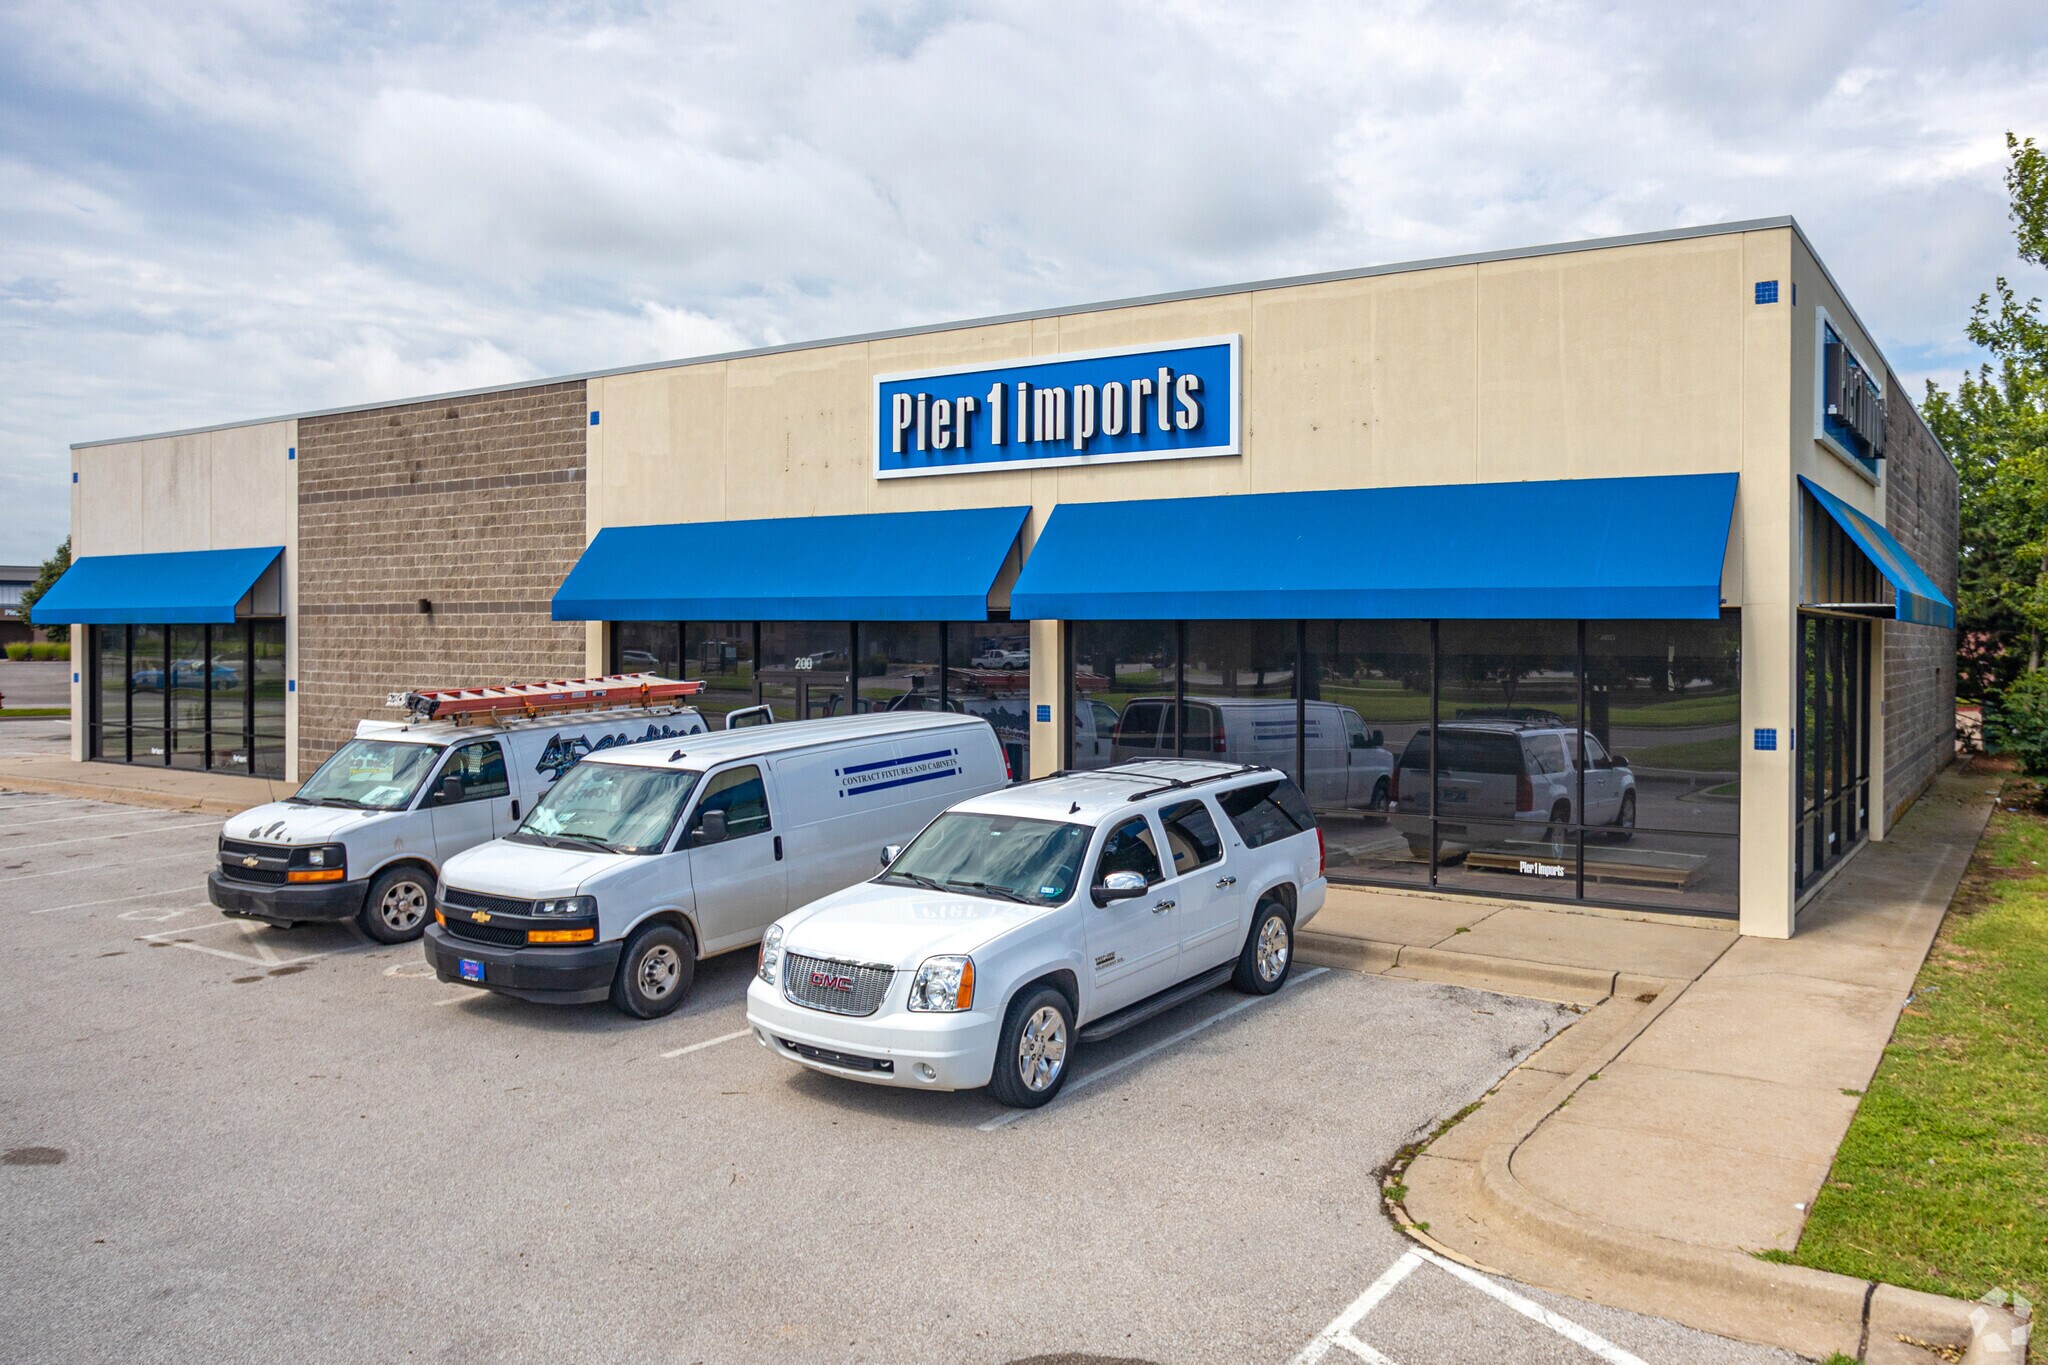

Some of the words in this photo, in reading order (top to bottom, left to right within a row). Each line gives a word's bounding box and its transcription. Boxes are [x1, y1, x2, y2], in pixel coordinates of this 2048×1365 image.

[892, 391, 977, 453] Pier
[986, 381, 1007, 446] 1
[1016, 366, 1204, 451] imports
[794, 657, 813, 670] 200
[842, 770, 881, 787] CONTRACT
[881, 766, 914, 780] FIXTURES
[914, 762, 928, 773] AND
[927, 757, 958, 771] CABINETS
[1519, 860, 1534, 874] Pier
[1538, 862, 1565, 877] imports
[810, 971, 853, 992] GMC
